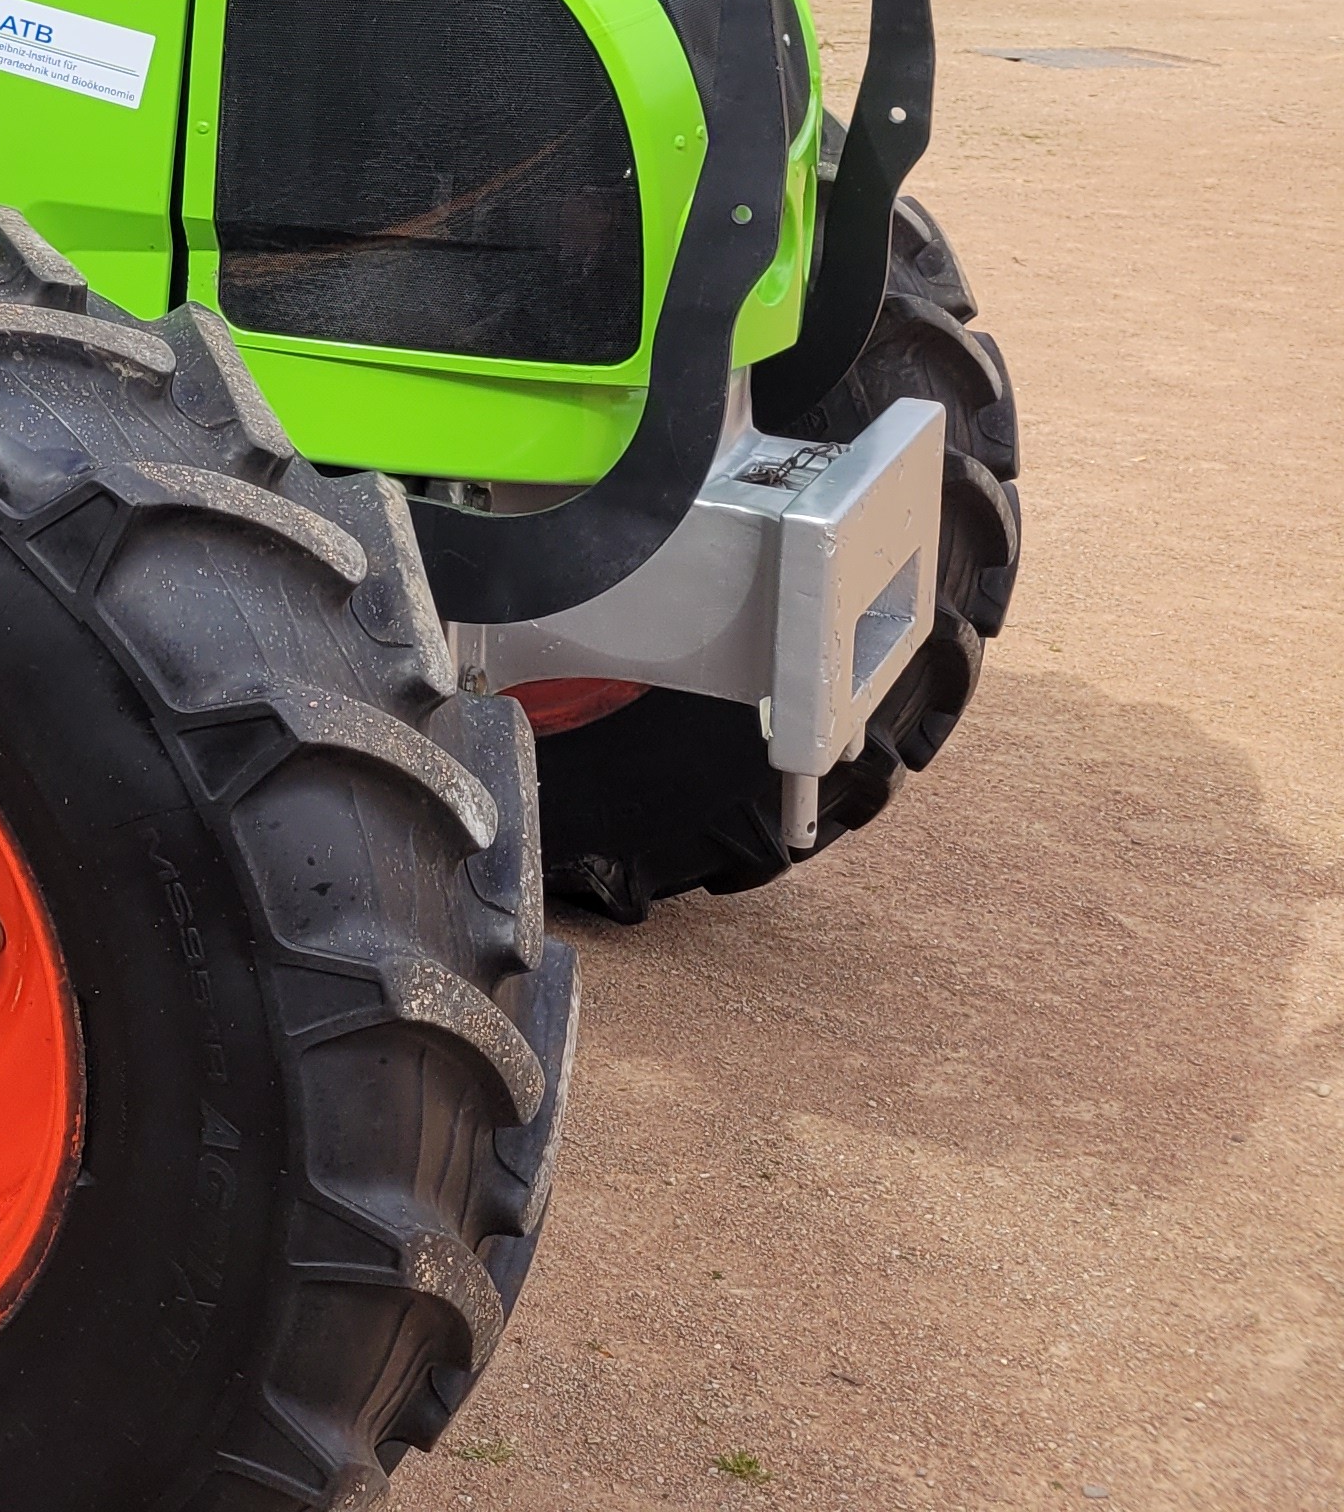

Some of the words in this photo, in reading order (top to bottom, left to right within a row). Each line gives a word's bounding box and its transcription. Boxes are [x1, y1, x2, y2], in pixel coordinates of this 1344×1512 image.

[63, 59, 78, 72] für
[51, 68, 70, 82] und
[71, 75, 135, 102] Bioökonomie
